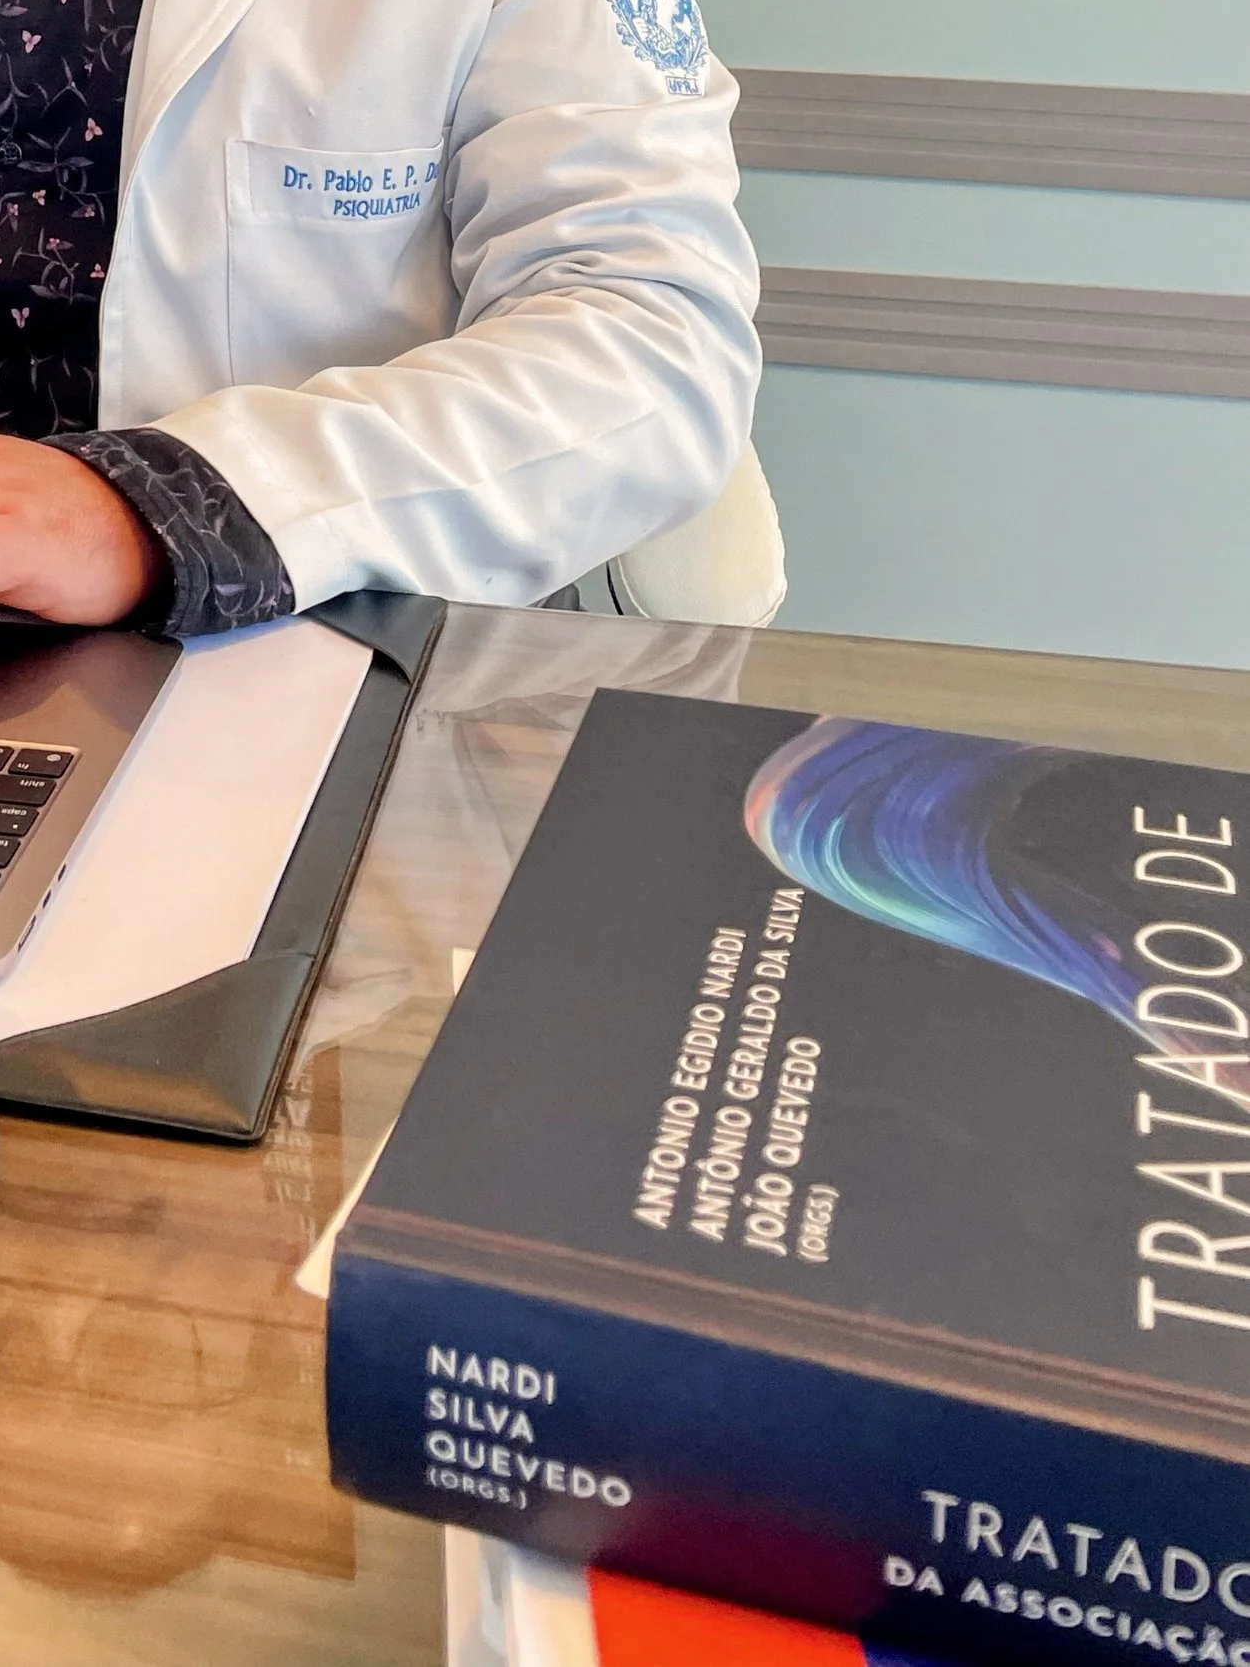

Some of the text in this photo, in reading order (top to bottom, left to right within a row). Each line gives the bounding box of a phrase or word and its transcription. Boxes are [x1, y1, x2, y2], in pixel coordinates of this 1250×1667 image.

[283, 165, 312, 190] Dr.
[323, 169, 374, 193] Pablo
[382, 168, 397, 190] E.
[404, 165, 417, 188] P.
[333, 191, 421, 219] PSIQUIATRIA
[18, 762, 29, 770] fn
[20, 779, 45, 787] shift
[2, 807, 27, 816] caps
[633, 926, 747, 1230] ANTONIO EGIDIO NARDI
[690, 887, 805, 1241] ANTÔNIO GERALDO DA SILVA
[1133, 805, 1250, 1331] TRATADO DE
[741, 1036, 822, 1258] JOÃO QUEVEDO
[428, 1344, 556, 1405] NARDI
[428, 1388, 535, 1444] SILVA
[427, 1430, 631, 1507] QUEVEDO
[883, 1555, 944, 1597] DA
